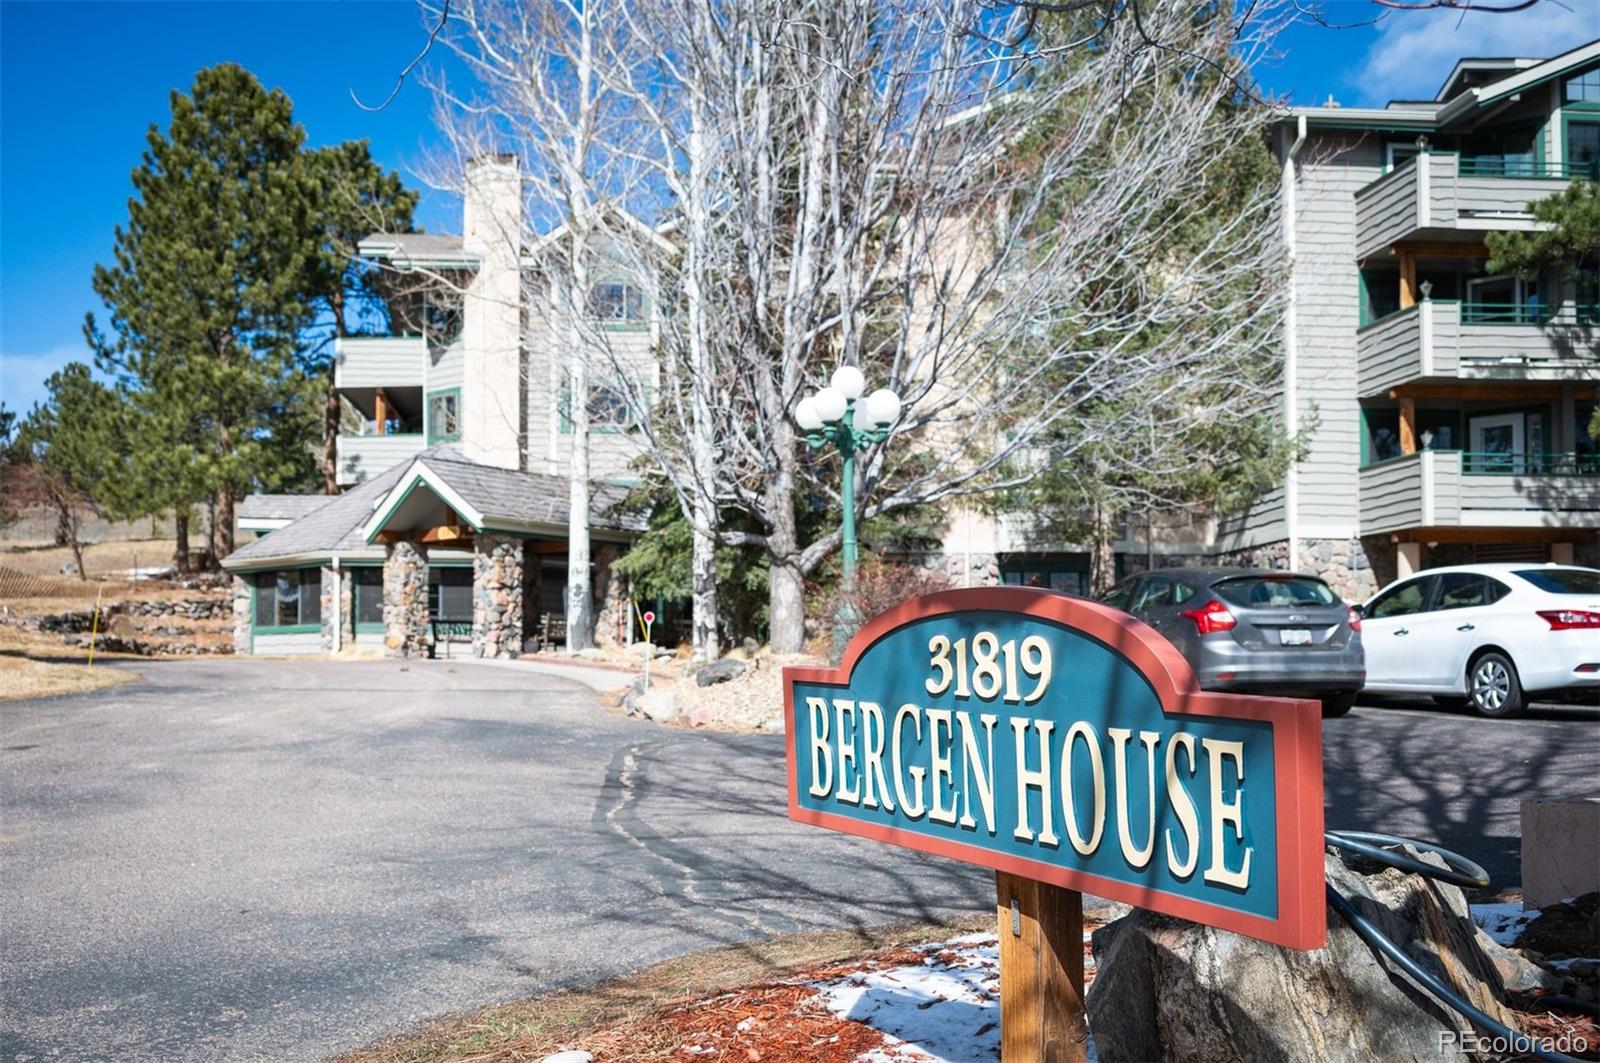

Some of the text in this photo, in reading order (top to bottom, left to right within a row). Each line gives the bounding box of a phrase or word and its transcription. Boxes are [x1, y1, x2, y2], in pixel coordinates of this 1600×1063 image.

[925, 631, 1053, 702] 31819
[805, 696, 1253, 889] BERGEN HOUSE
